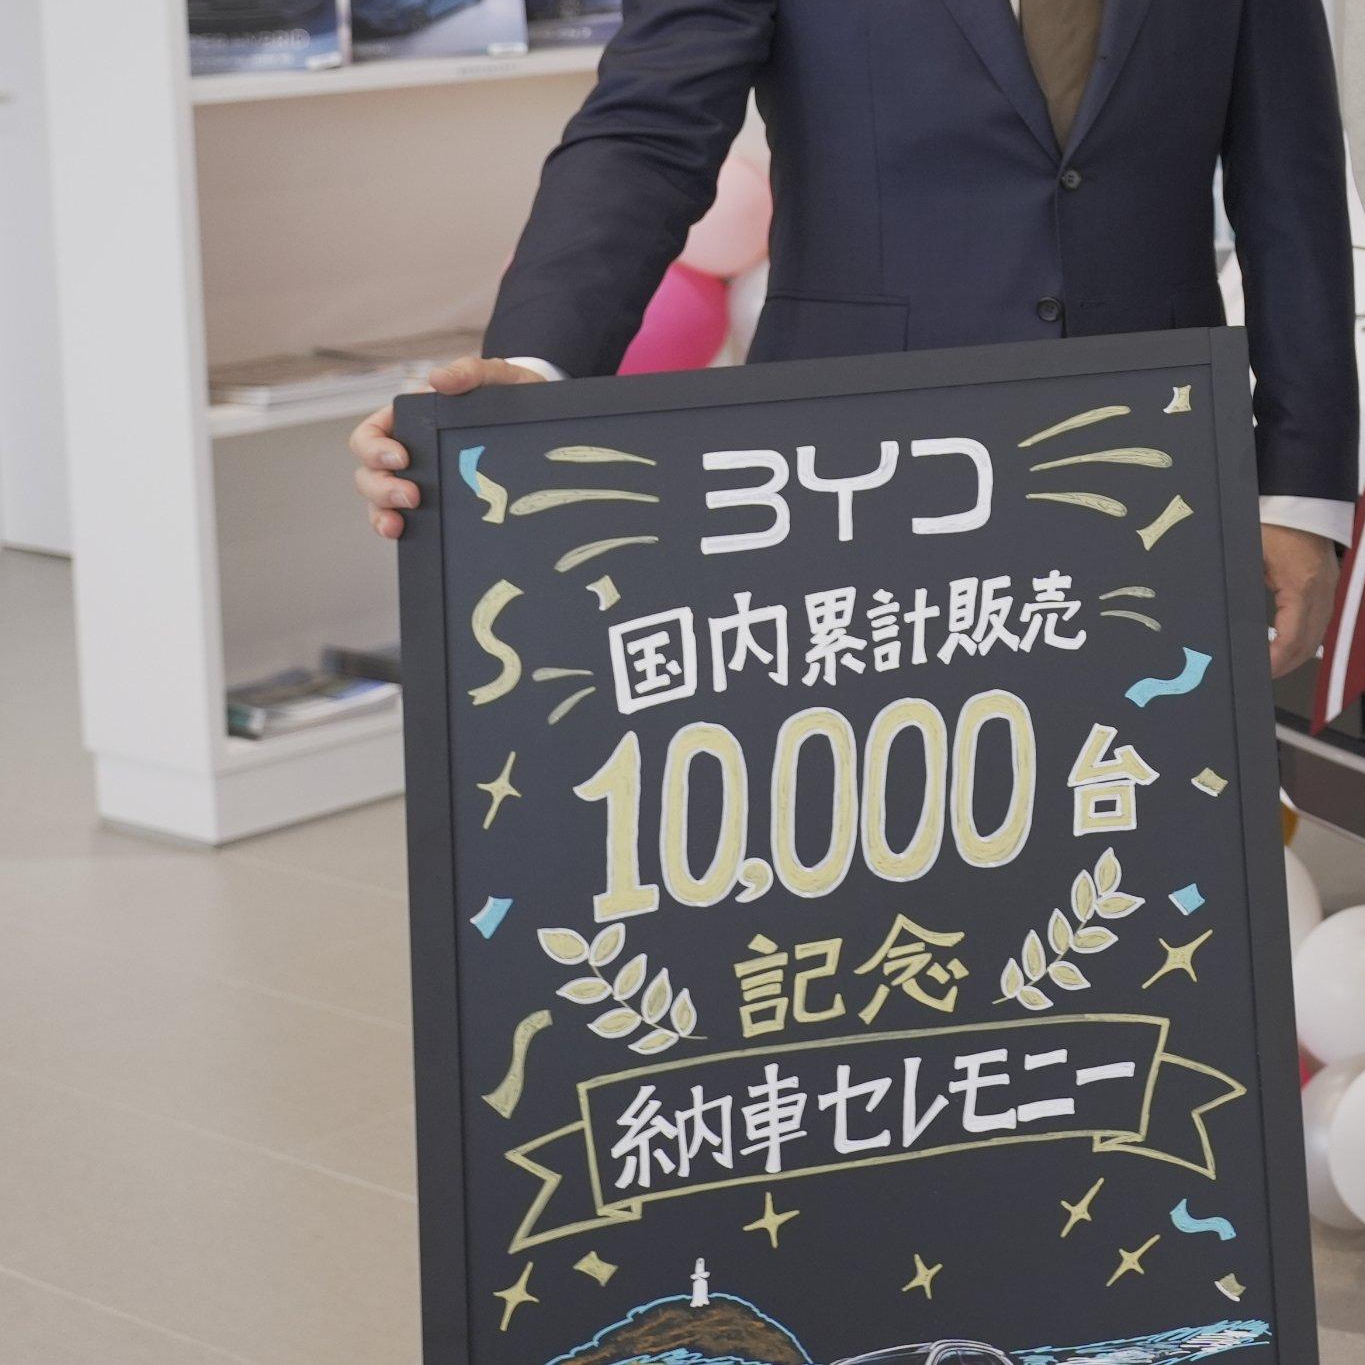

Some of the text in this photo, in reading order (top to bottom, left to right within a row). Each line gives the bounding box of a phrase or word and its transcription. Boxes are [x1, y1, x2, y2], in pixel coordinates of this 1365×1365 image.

[699, 437, 994, 556] BYD
[607, 569, 1088, 715] 国内累計販売
[734, 913, 970, 1038] 記念
[610, 1048, 1137, 1189] 納車セレモニー
